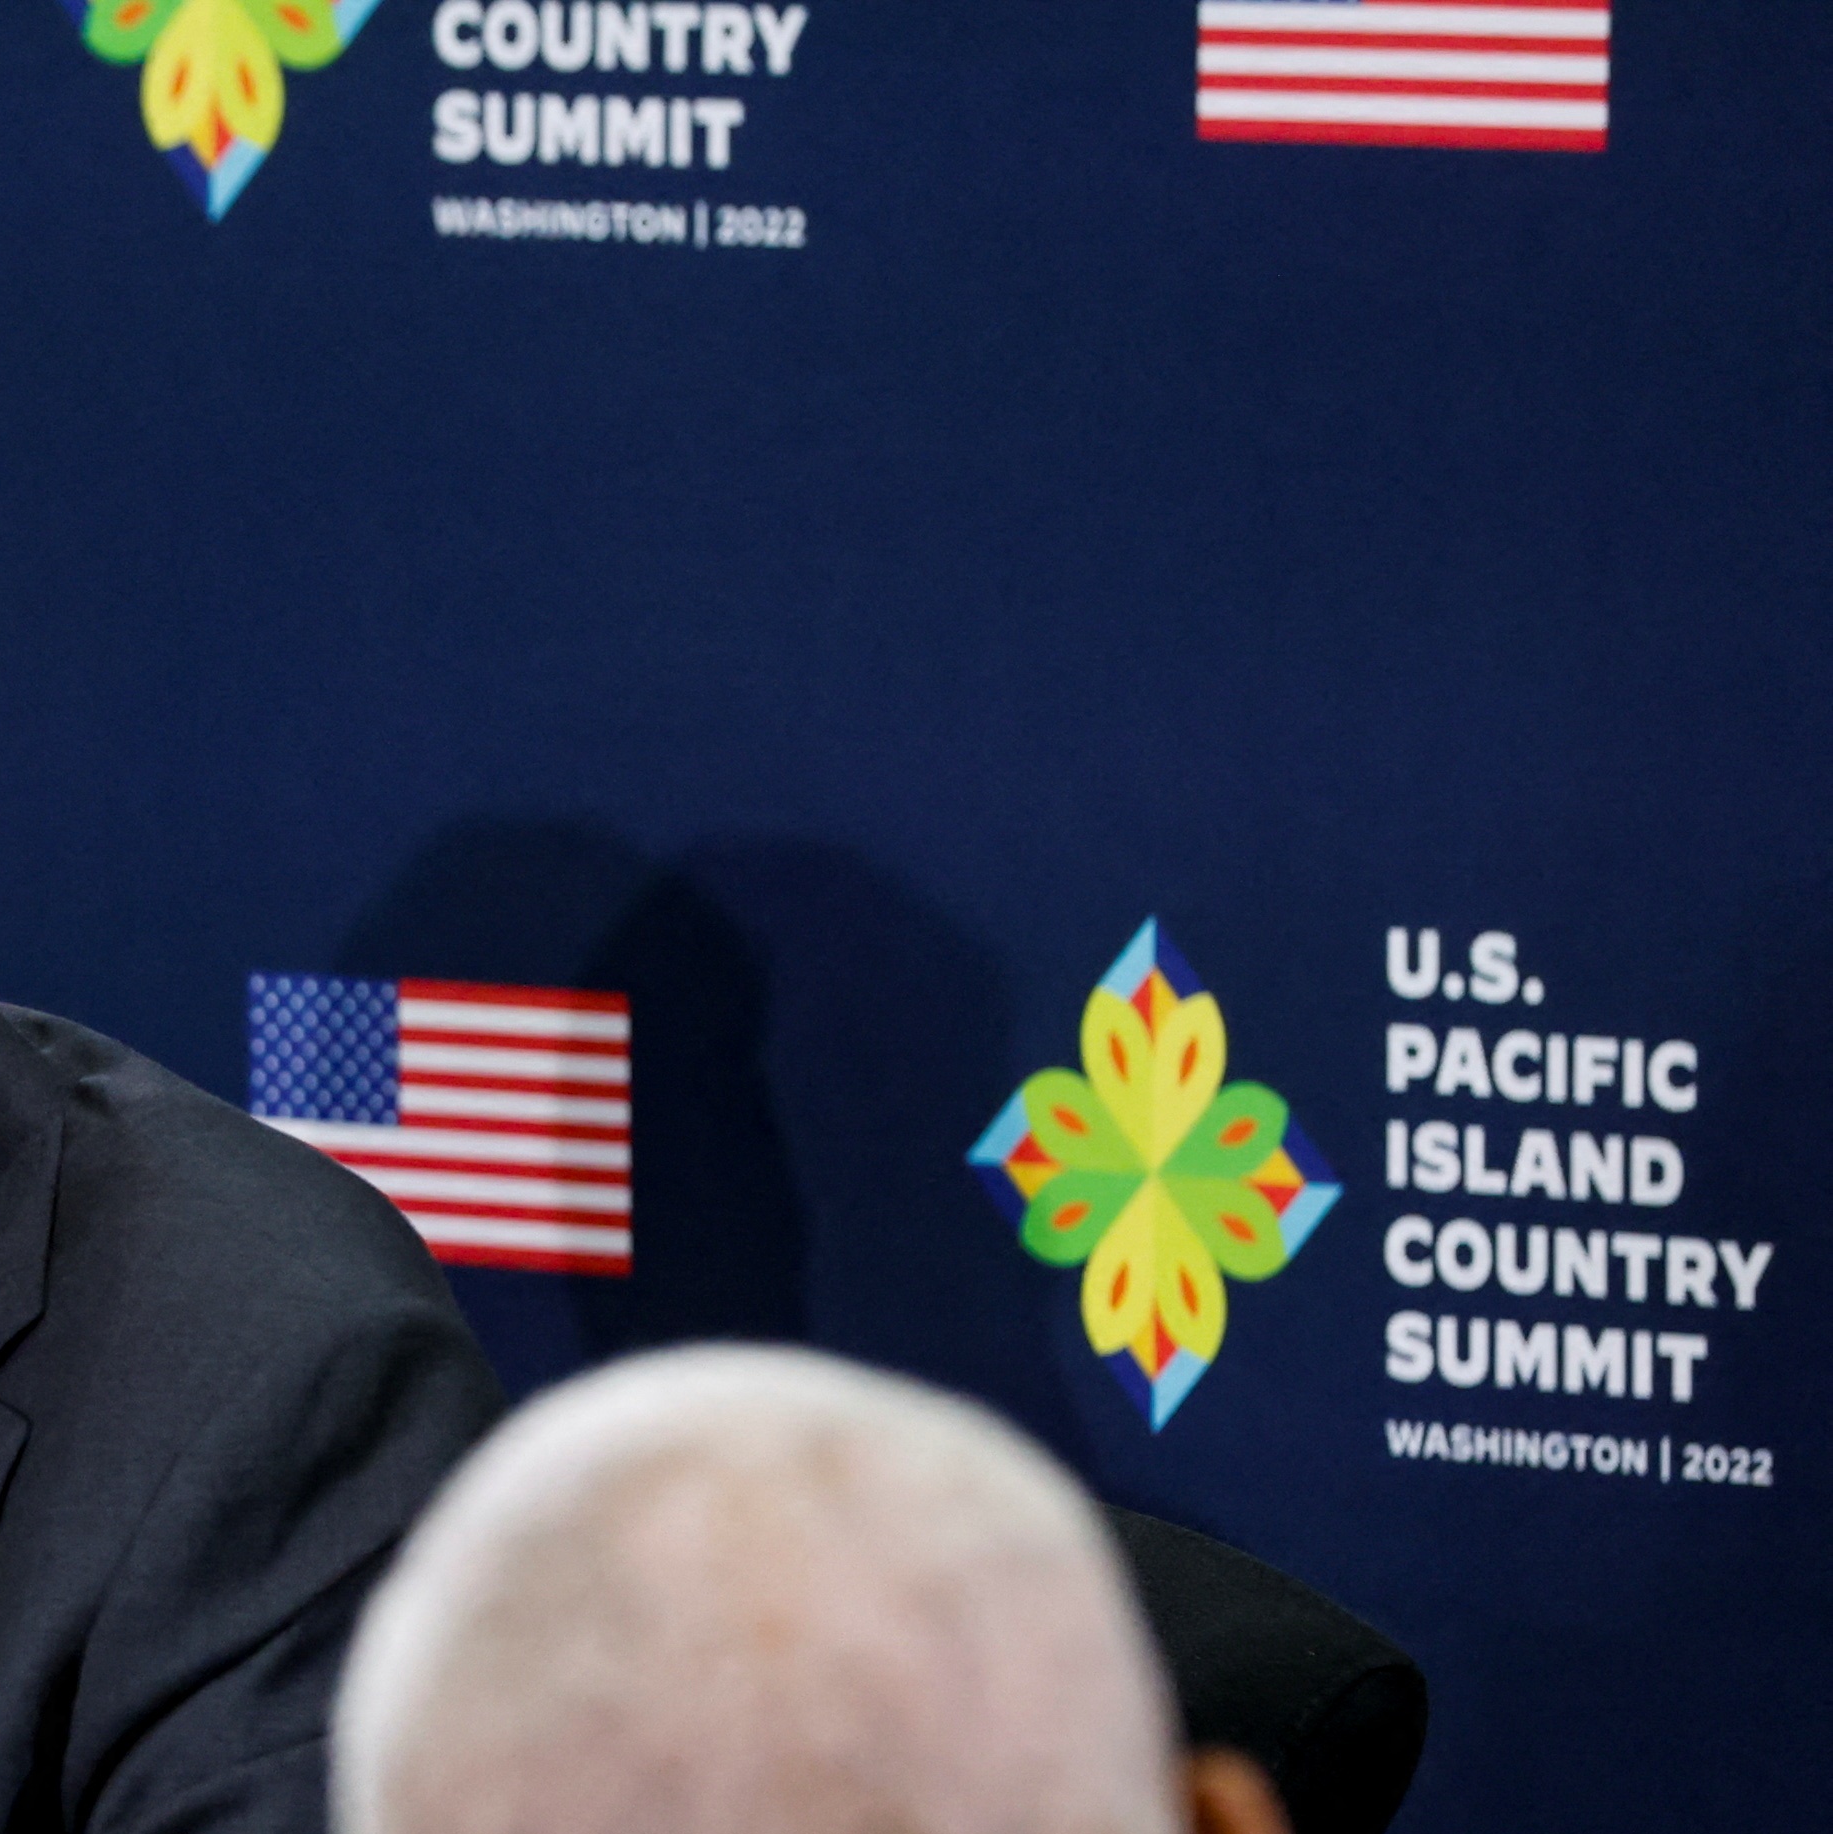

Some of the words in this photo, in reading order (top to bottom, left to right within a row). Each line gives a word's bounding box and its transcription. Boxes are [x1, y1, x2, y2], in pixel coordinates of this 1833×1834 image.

[432, 0, 809, 75] COUNTRY
[432, 88, 745, 169] SUMMIT
[432, 196, 687, 243] WASHINGTON
[715, 204, 807, 248] 2022
[1386, 926, 1545, 1005] U.S.
[1386, 1022, 1698, 1113] PACIFIC
[1386, 1118, 1685, 1207] ISLAND
[1384, 1214, 1774, 1309] COUNTRY
[1385, 1310, 1708, 1404] SUMMIT
[1385, 1418, 1649, 1477] WASHINGTON
[1682, 1442, 1774, 1487] 2022
